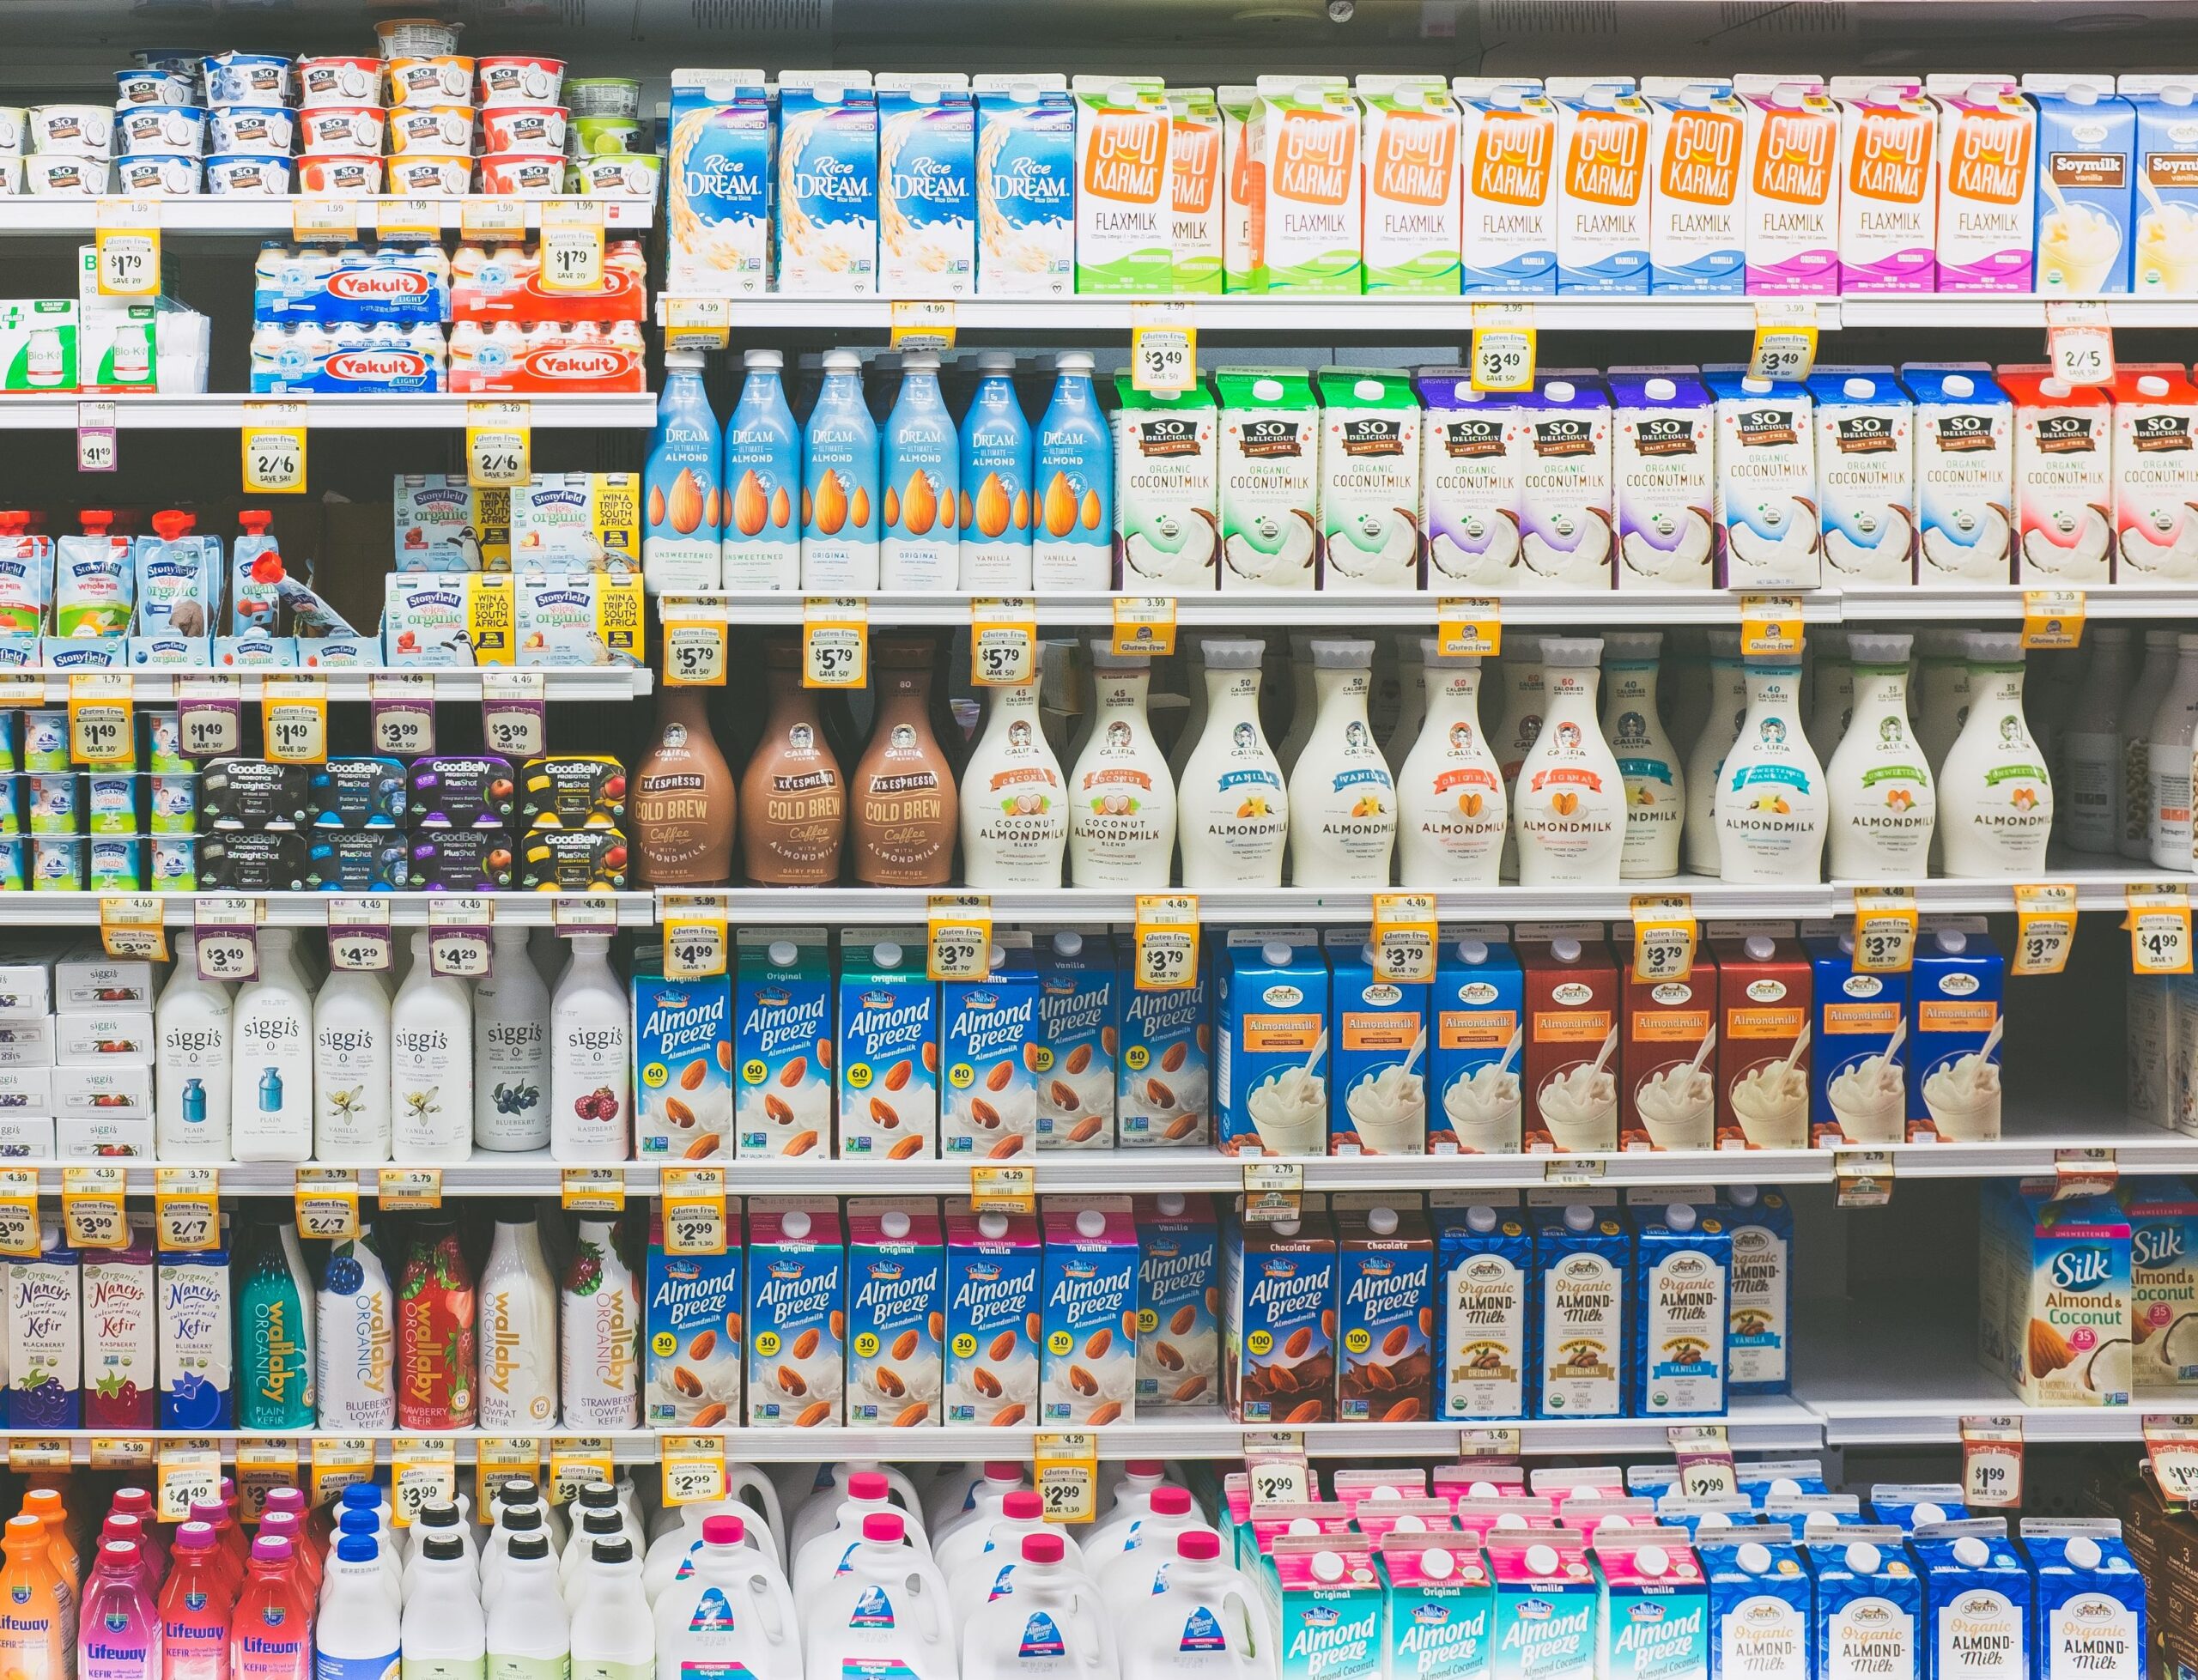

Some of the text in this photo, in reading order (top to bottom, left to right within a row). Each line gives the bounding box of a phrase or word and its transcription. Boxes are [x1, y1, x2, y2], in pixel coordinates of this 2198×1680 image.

[413, 69, 431, 79] SO
[1099, 114, 1159, 167] GOOD
[1581, 117, 1638, 167] GOOD
[1964, 116, 2023, 167] GOOD
[704, 155, 744, 173] Rice
[2057, 158, 2120, 174] Soymilk
[1094, 161, 1157, 197] KARMA
[1575, 161, 1635, 199] KARMA
[1958, 161, 2017, 197] KARMA
[2075, 173, 2104, 182] vanilla
[1096, 213, 1157, 230] FLAXMILK
[1577, 215, 1636, 233] FLAXMILK
[1959, 213, 2019, 231] FLAXMILK
[344, 278, 415, 294] Yakult
[543, 357, 612, 373] Yakult
[1155, 422, 1184, 434] SO
[1461, 423, 1491, 435] SO
[1952, 418, 1980, 430] SO
[665, 453, 708, 462] ALMOND
[973, 457, 1015, 465] ALMOND
[1150, 465, 1191, 474] ORGANIC
[1946, 460, 1986, 469] ORGANIC
[1132, 476, 1209, 488] COCONUTMILK
[1436, 476, 1514, 488] COCONUTMILK
[1928, 470, 2003, 482] COCONUTMILK
[534, 491, 583, 506] Stonyfield
[599, 501, 616, 510] TRIP
[532, 511, 586, 525] organic
[600, 510, 632, 519] SOUTH
[599, 518, 633, 526] AFRICA
[76, 563, 120, 576] Stonyfield
[410, 593, 459, 605] Stonyfield
[408, 611, 461, 626] organic
[56, 652, 109, 666] Stonyfield
[228, 763, 285, 776] GoodBelly
[545, 762, 602, 776] GoodBelly
[230, 781, 282, 791] StraightShot
[793, 773, 834, 788] ESPRESSO
[768, 797, 840, 821] COLD BREW
[1085, 819, 1145, 828] COCONUT
[1524, 822, 1612, 832] ALMONDMILK
[1726, 819, 1814, 832] ALMONDMILK
[790, 826, 828, 843] Coffee
[1075, 827, 1159, 840] ALMONDMILK
[867, 842, 940, 864] ALMONDMILK
[767, 972, 801, 981] Original
[1266, 992, 1301, 1002] SPROUTS
[744, 994, 825, 1035] Almond
[1734, 1015, 1797, 1025] Almondmilk
[244, 1016, 300, 1040] siggi's
[1250, 1021, 1315, 1031] Almondmilk
[319, 1028, 373, 1050] siggi's
[761, 1020, 817, 1052] Breeze
[768, 1040, 811, 1058] Almondmilk
[747, 1064, 762, 1075] 60
[955, 1070, 969, 1079] 80
[1367, 1241, 1408, 1251] Chocolate
[2052, 1251, 2112, 1288] Silk
[101, 1271, 138, 1284] Organic
[1347, 1264, 1427, 1305] Almond
[1556, 1279, 1612, 1296] Organic
[90, 1282, 145, 1308] Nancy's
[1556, 1295, 1614, 1307] ALMOND-
[2045, 1292, 2122, 1307] Almond &
[1364, 1289, 1418, 1321] Breeze
[1563, 1307, 1604, 1322] Milk
[2049, 1309, 2122, 1325] Coconut
[99, 1317, 136, 1337] Kefir
[658, 1337, 671, 1347] 30
[1349, 1334, 1367, 1344] 100
[2078, 1331, 2091, 1341] 35
[255, 1303, 269, 1387] ORGANIC
[262, 1300, 294, 1403] wallaby
[1671, 1364, 1702, 1374] VANILLA
[581, 1395, 636, 1407] STRAWBERRY
[256, 1406, 284, 1416] PLAIN
[590, 1404, 629, 1416] LOWFAT
[257, 1416, 283, 1424] KEFIR
[598, 1415, 623, 1425] KEFIR
[1314, 1590, 1350, 1599] Original
[1964, 1604, 1999, 1614] SPROUTS
[167, 1622, 223, 1641] Lifeway
[1951, 1618, 2011, 1639] Organic
[1289, 1612, 1375, 1659] Almond
[1952, 1636, 2014, 1649] ALMOND-
[166, 1647, 189, 1657] KEFIR
[1307, 1639, 1367, 1676] Breeze
[1961, 1650, 2004, 1666] Milk
